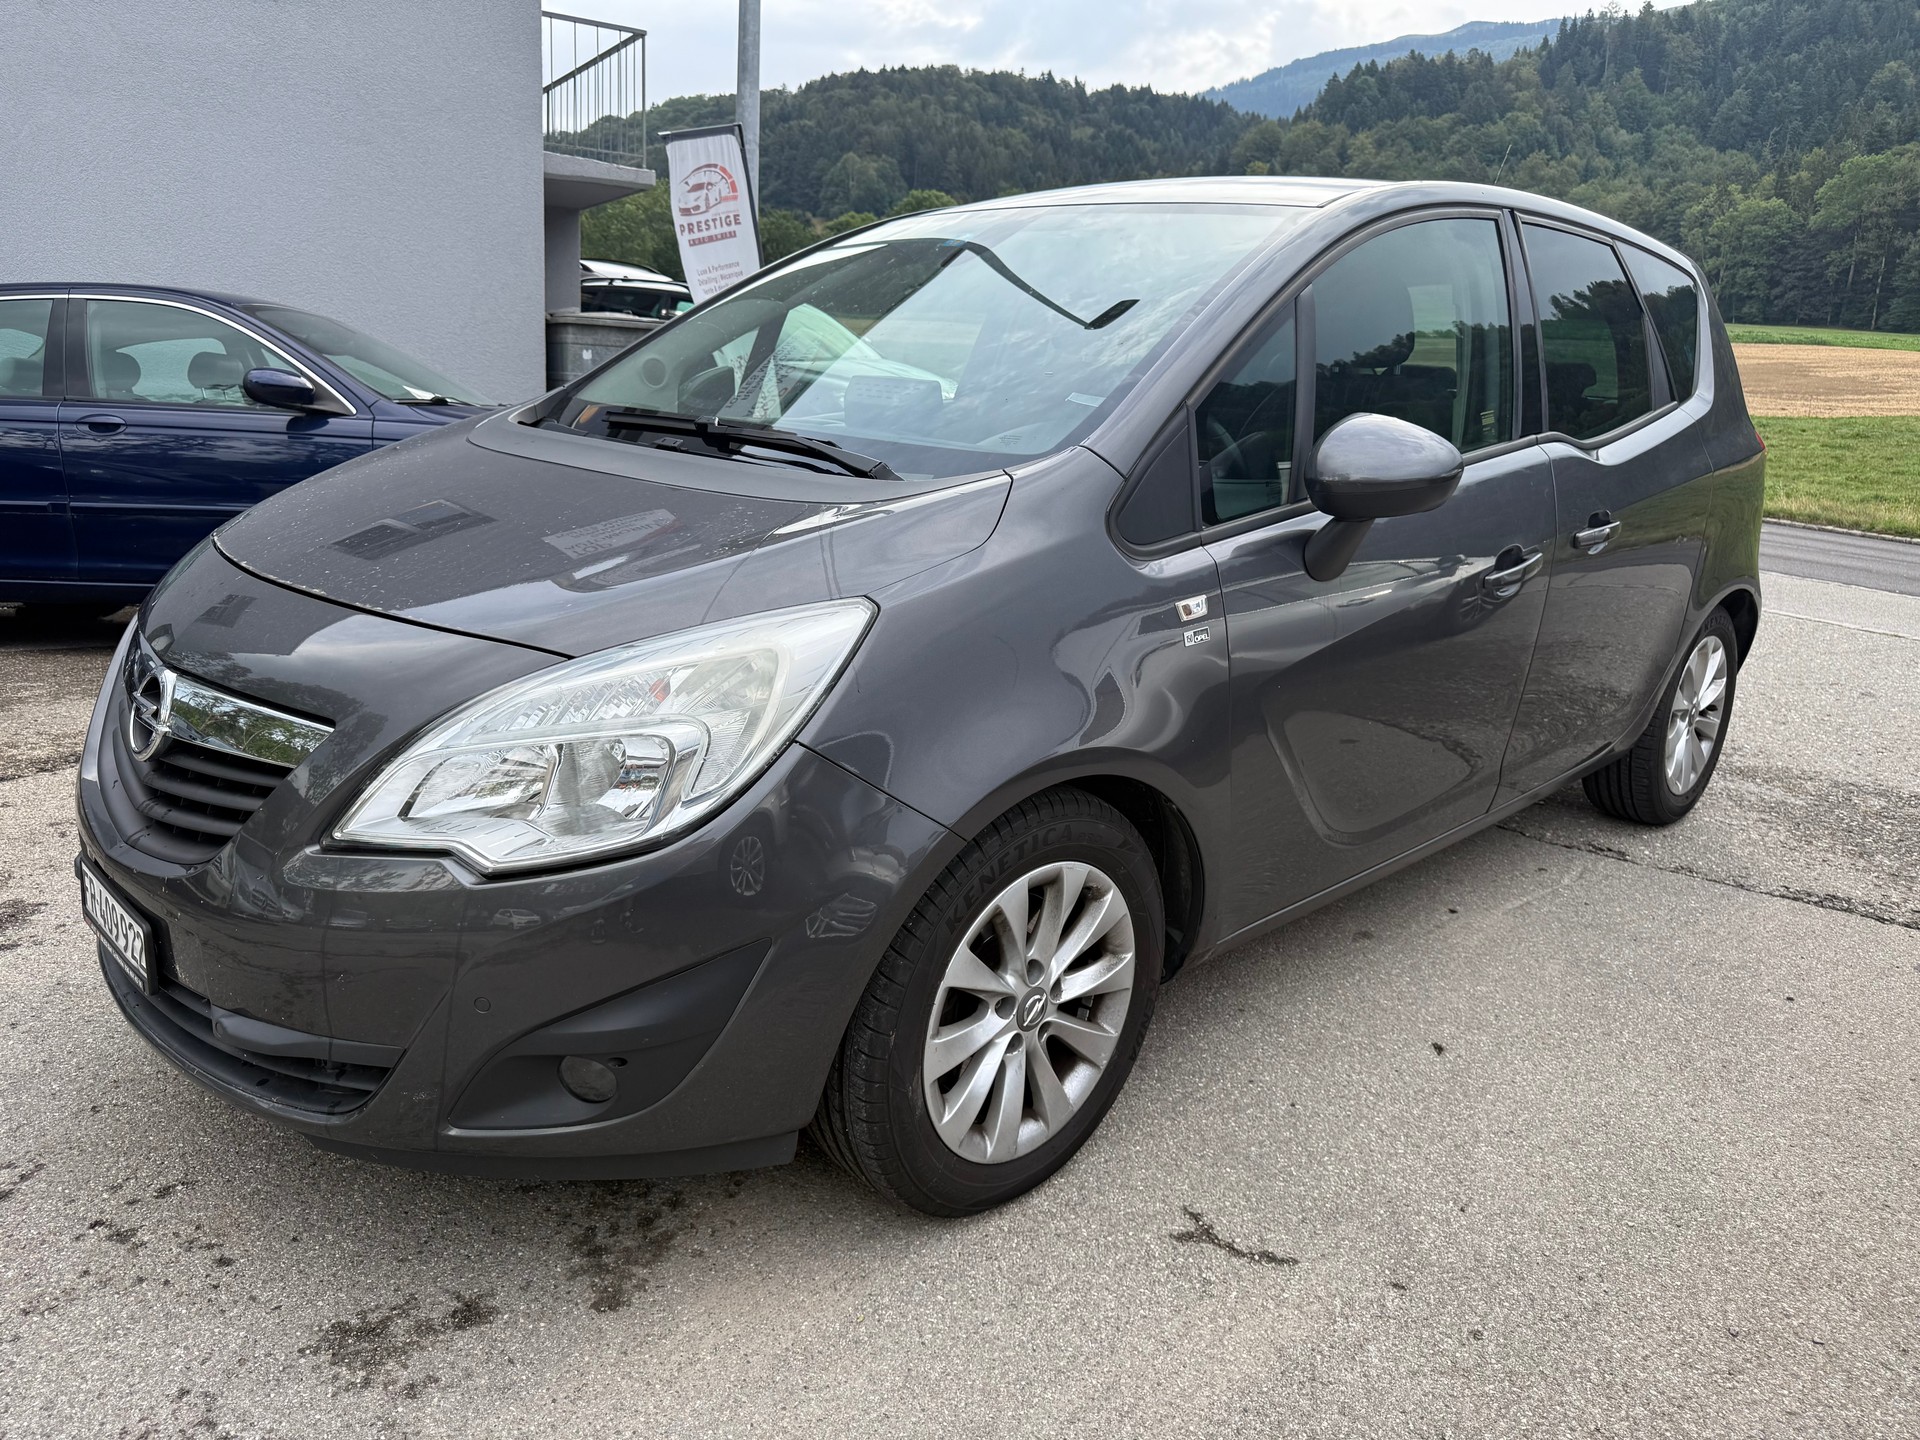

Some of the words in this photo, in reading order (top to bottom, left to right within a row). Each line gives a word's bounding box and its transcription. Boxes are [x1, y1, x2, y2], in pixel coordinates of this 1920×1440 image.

[679, 214, 741, 236] PRESTIGE
[689, 235, 709, 246] AUTO
[944, 823, 1073, 933] KENETICA
